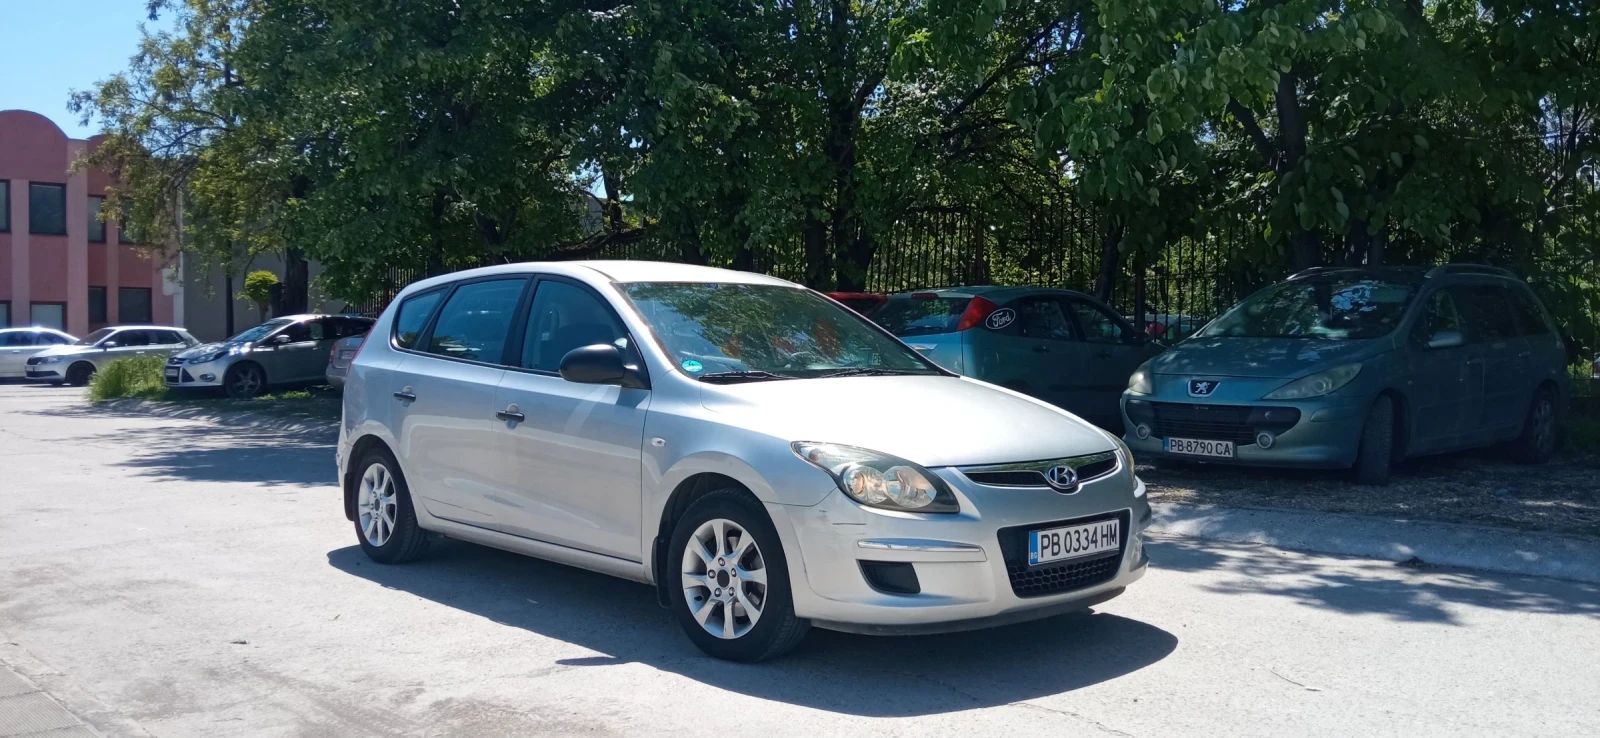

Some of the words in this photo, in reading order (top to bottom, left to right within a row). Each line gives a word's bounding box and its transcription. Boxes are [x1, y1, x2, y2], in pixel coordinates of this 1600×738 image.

[992, 311, 1011, 327] Ford
[1170, 439, 1184, 452] PB
[1186, 441, 1213, 454] 8790
[1215, 443, 1231, 455] CA
[1041, 533, 1061, 558] PB
[1064, 526, 1098, 554] 0334
[1101, 523, 1117, 547] HM
